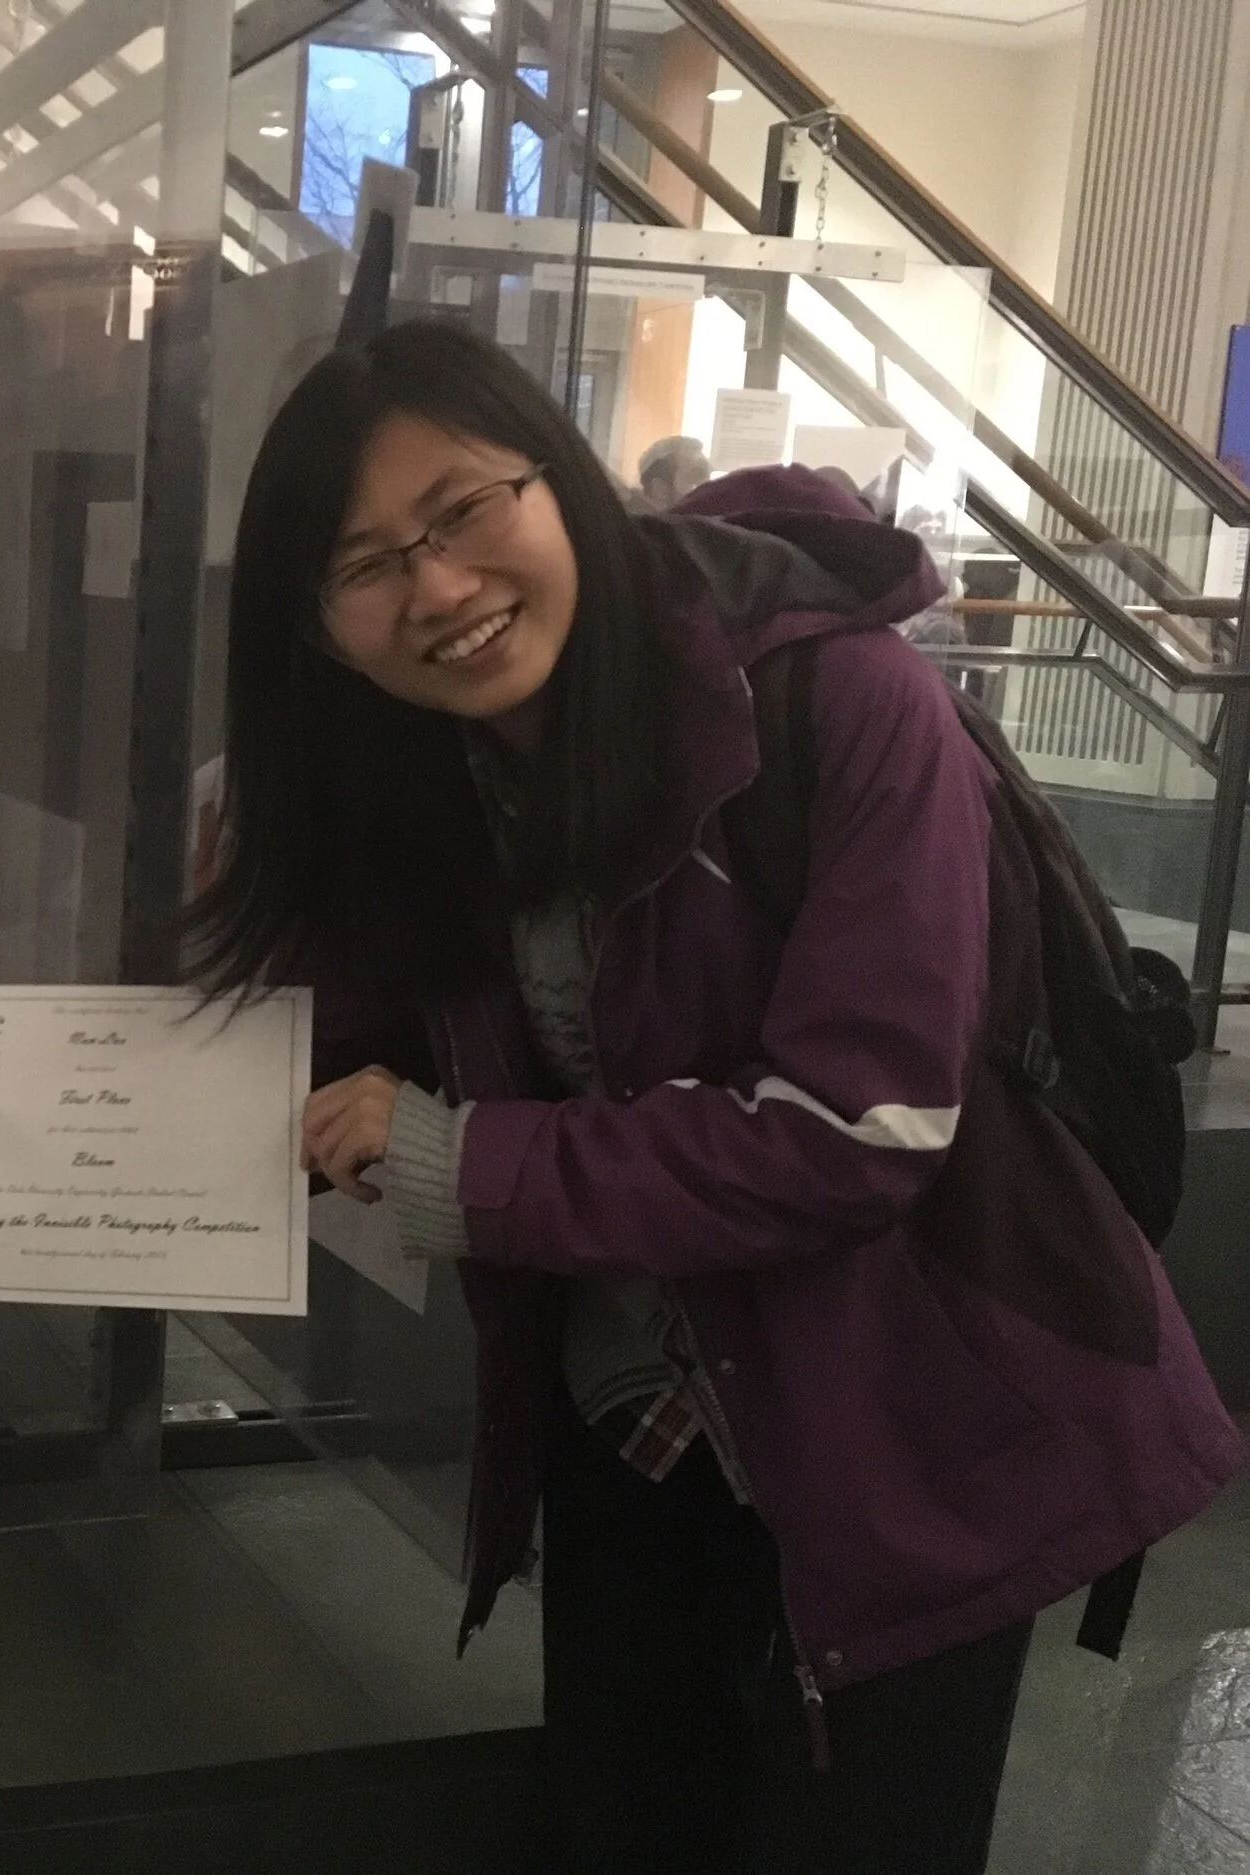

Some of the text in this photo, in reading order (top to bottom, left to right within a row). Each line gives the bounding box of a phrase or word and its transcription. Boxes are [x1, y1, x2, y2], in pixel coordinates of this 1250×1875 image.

[8, 1213, 29, 1227] the
[97, 1213, 179, 1236] Photography
[182, 1215, 261, 1235] Competition
